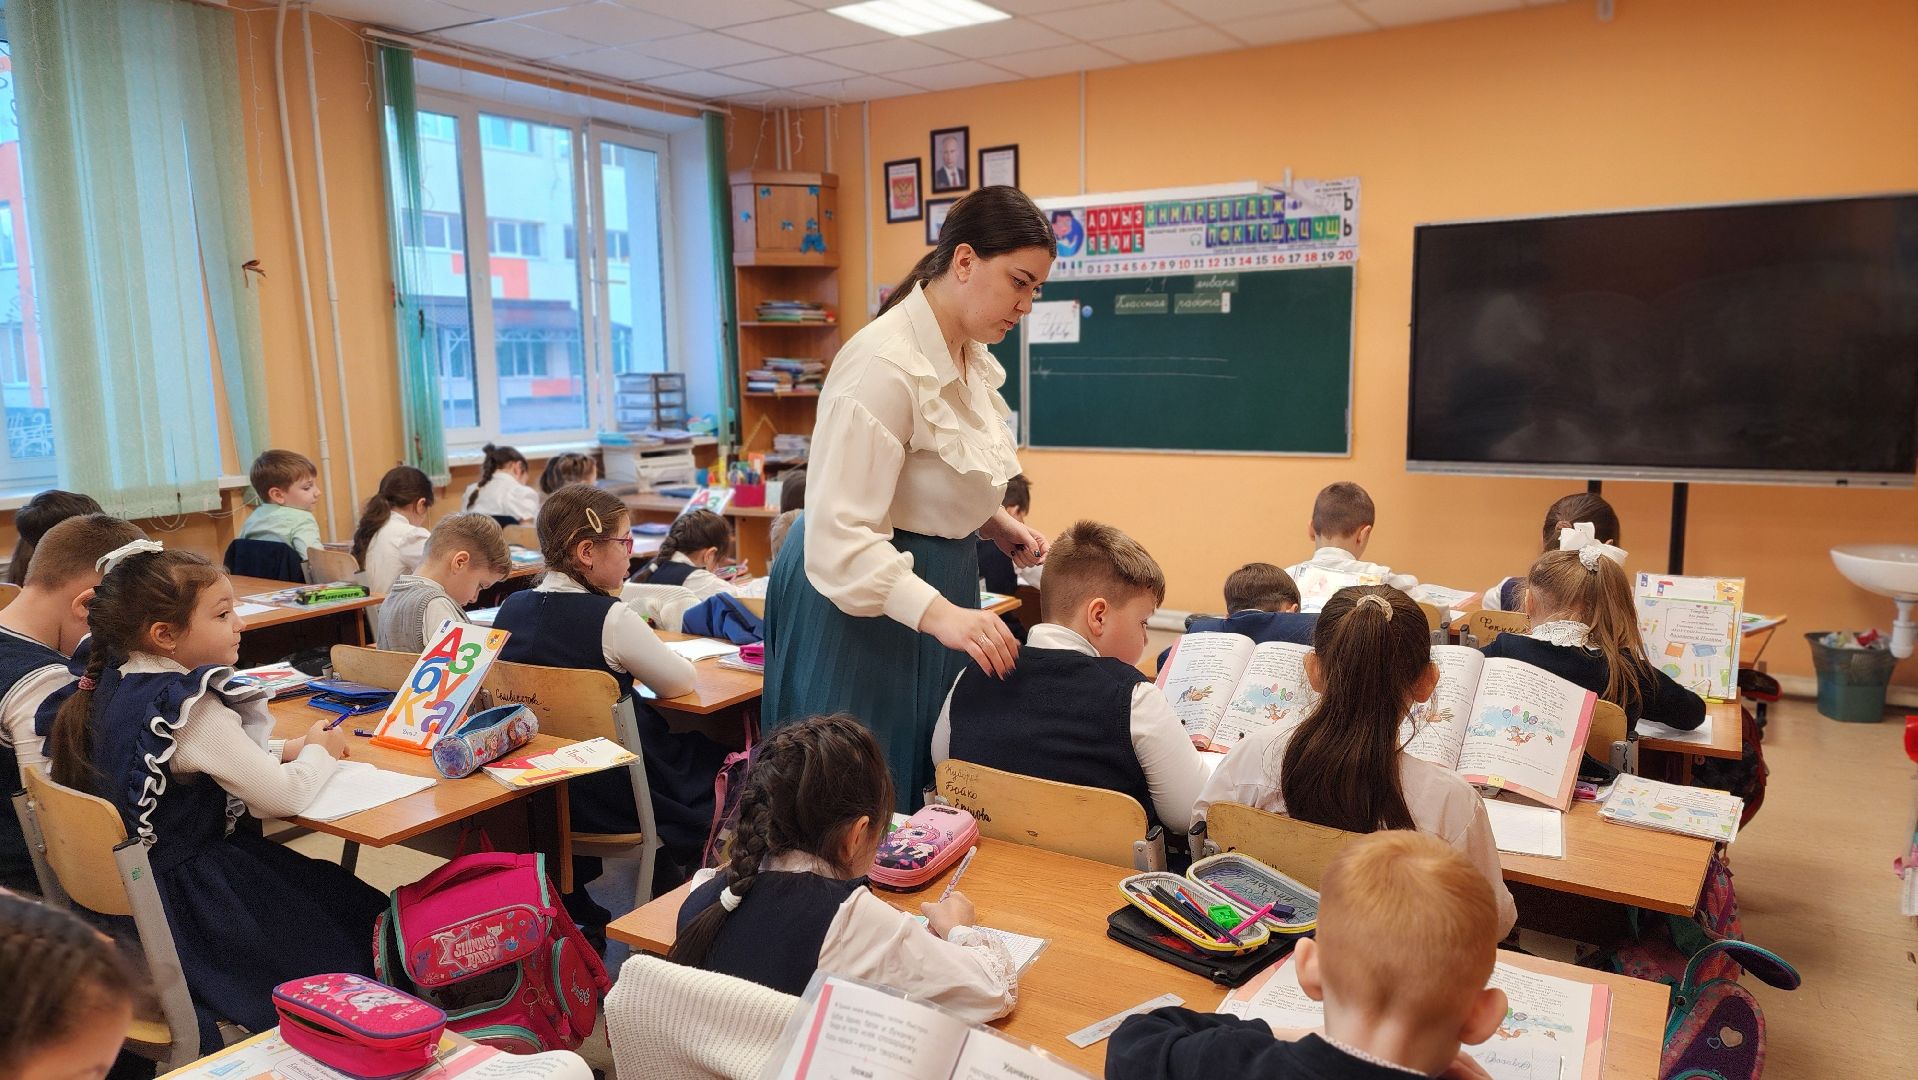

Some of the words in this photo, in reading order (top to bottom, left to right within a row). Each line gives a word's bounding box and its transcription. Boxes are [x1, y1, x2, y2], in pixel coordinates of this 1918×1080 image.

[1178, 259, 1191, 269] 10
[1194, 258, 1204, 268] 11
[1208, 257, 1220, 267] 12
[1223, 257, 1236, 266] 13
[1239, 256, 1252, 265] 14
[1255, 255, 1268, 264] 15
[1272, 254, 1285, 264] 16
[1288, 253, 1301, 263] 17
[1304, 252, 1318, 262] 18
[1321, 251, 1334, 261] 19
[1338, 249, 1353, 260] 20
[453, 934, 496, 958] SHINING
[464, 948, 495, 969] BABY
